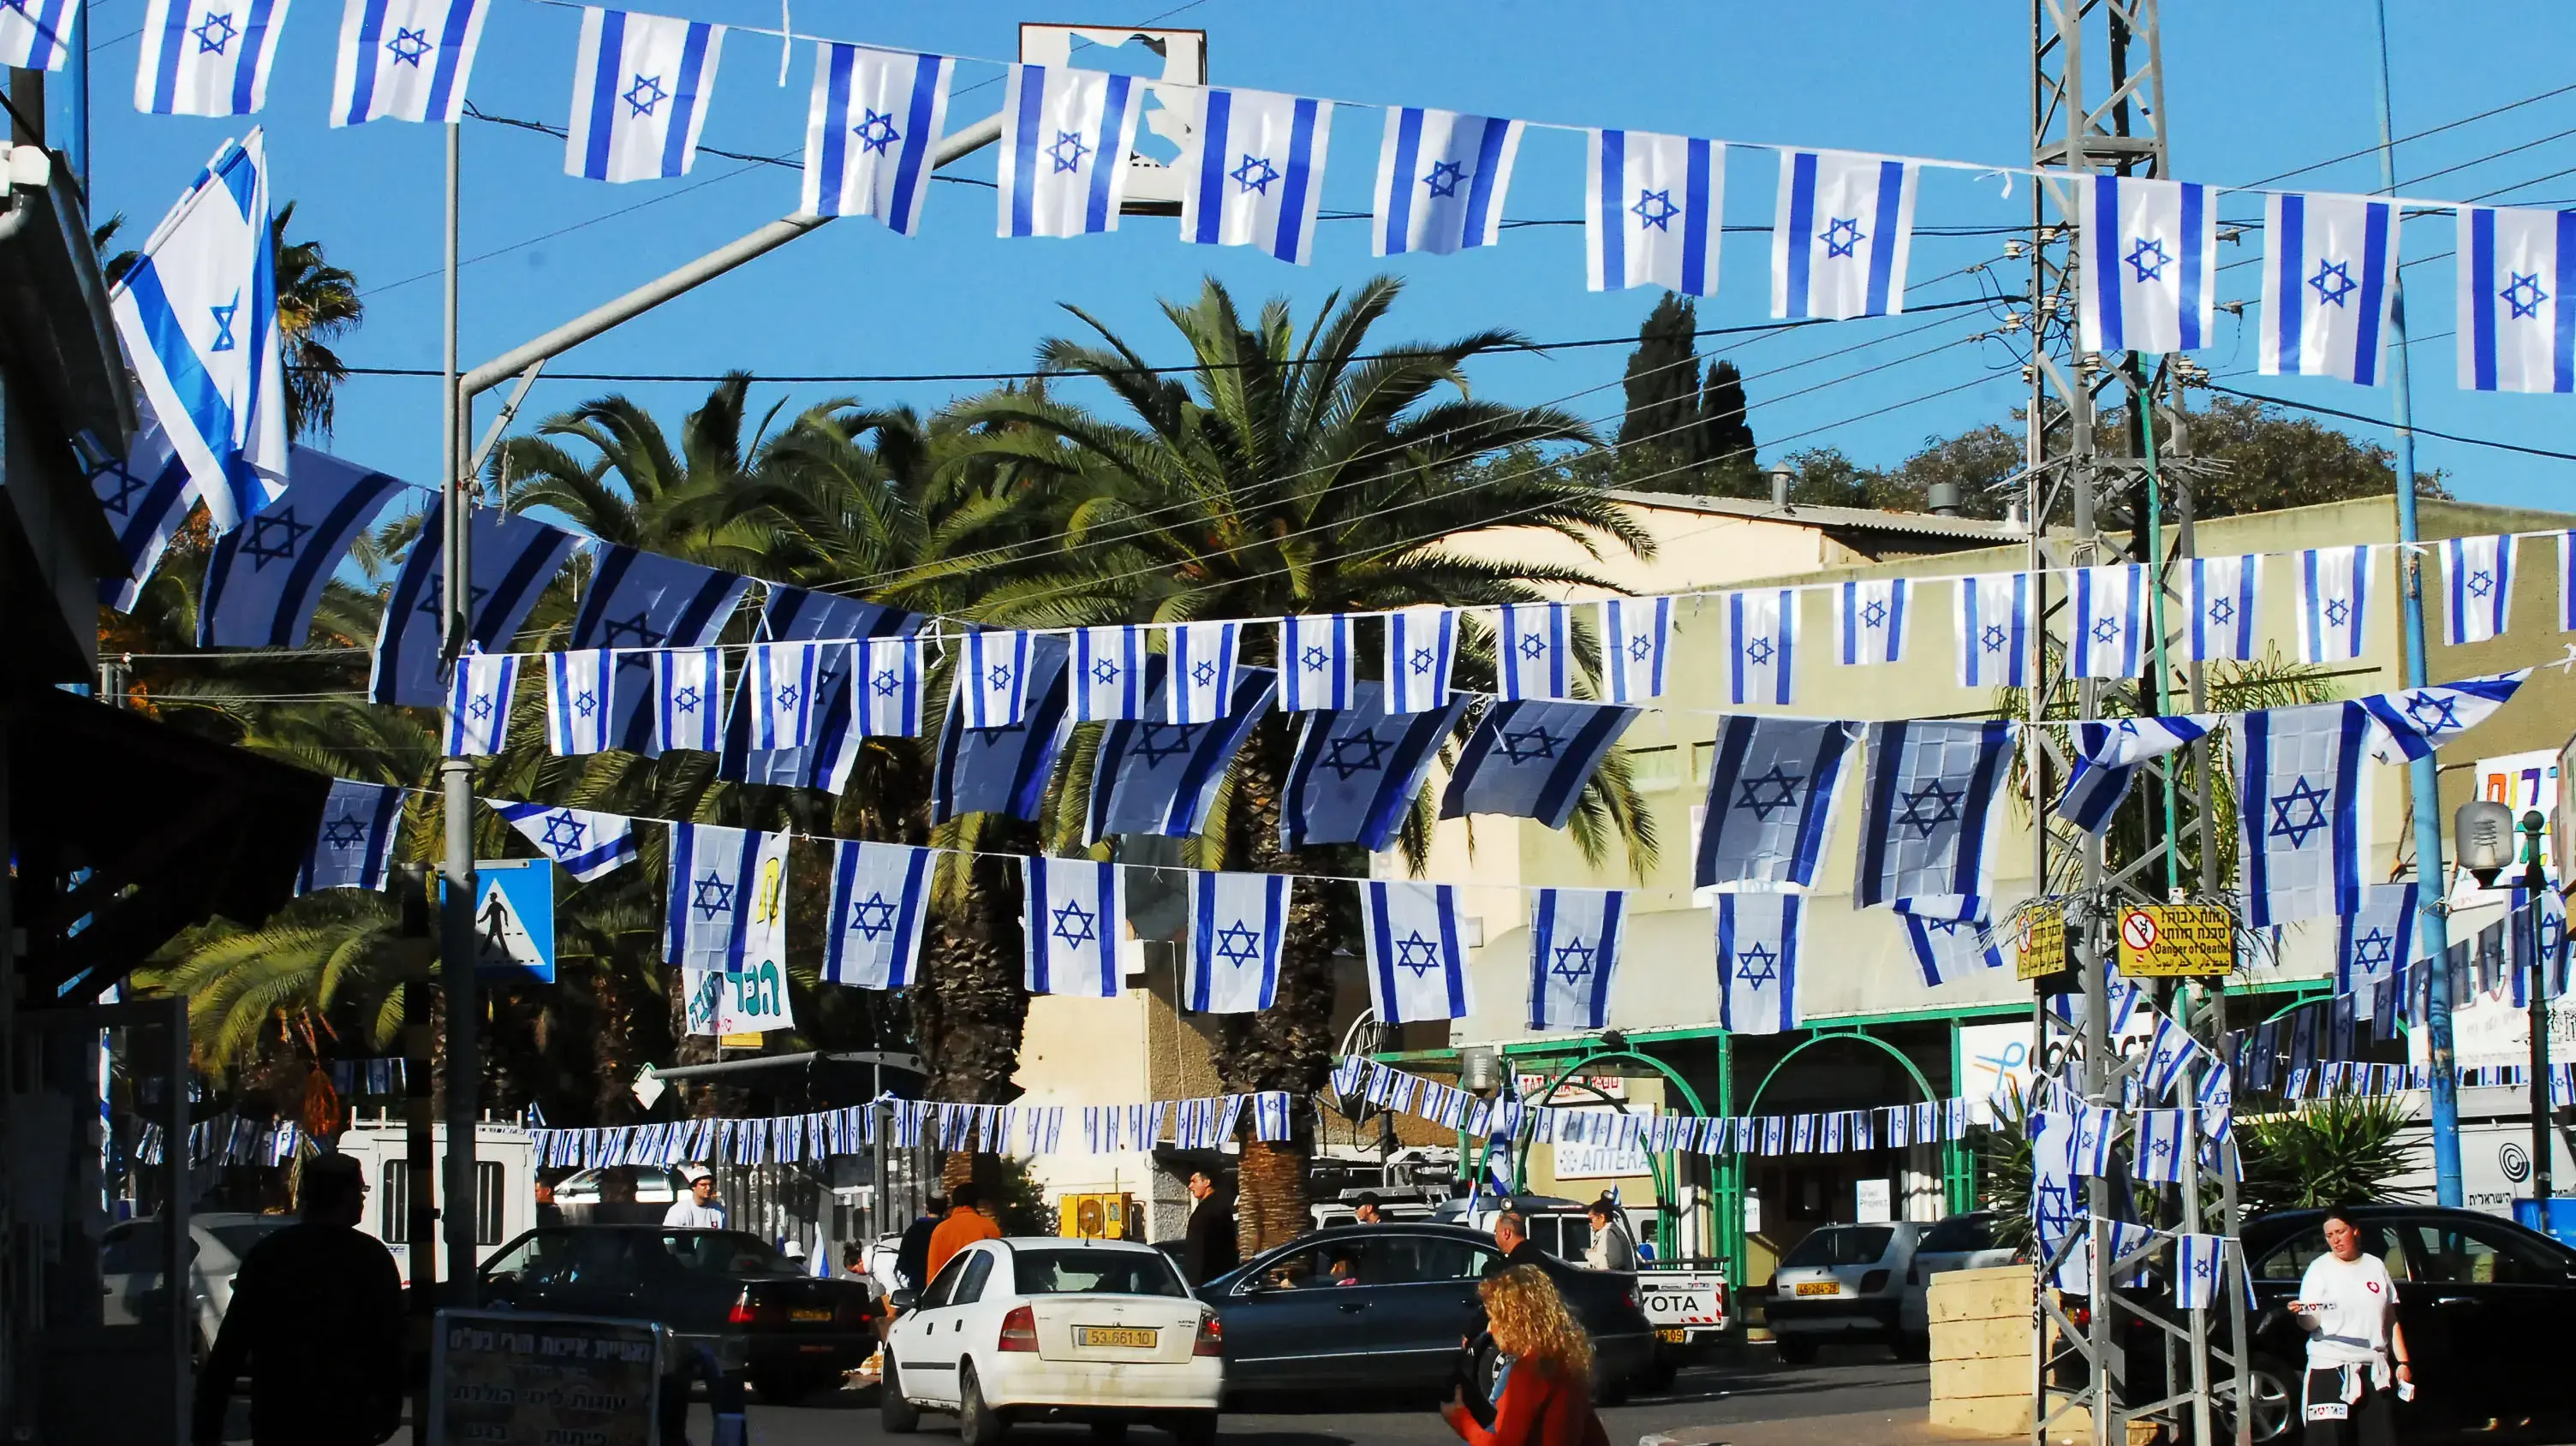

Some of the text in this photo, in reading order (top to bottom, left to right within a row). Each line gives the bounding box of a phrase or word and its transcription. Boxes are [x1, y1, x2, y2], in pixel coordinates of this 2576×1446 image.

[2155, 943, 2187, 957] Danger
[2189, 943, 2197, 954] of
[1643, 1295, 1699, 1312] YOTA
